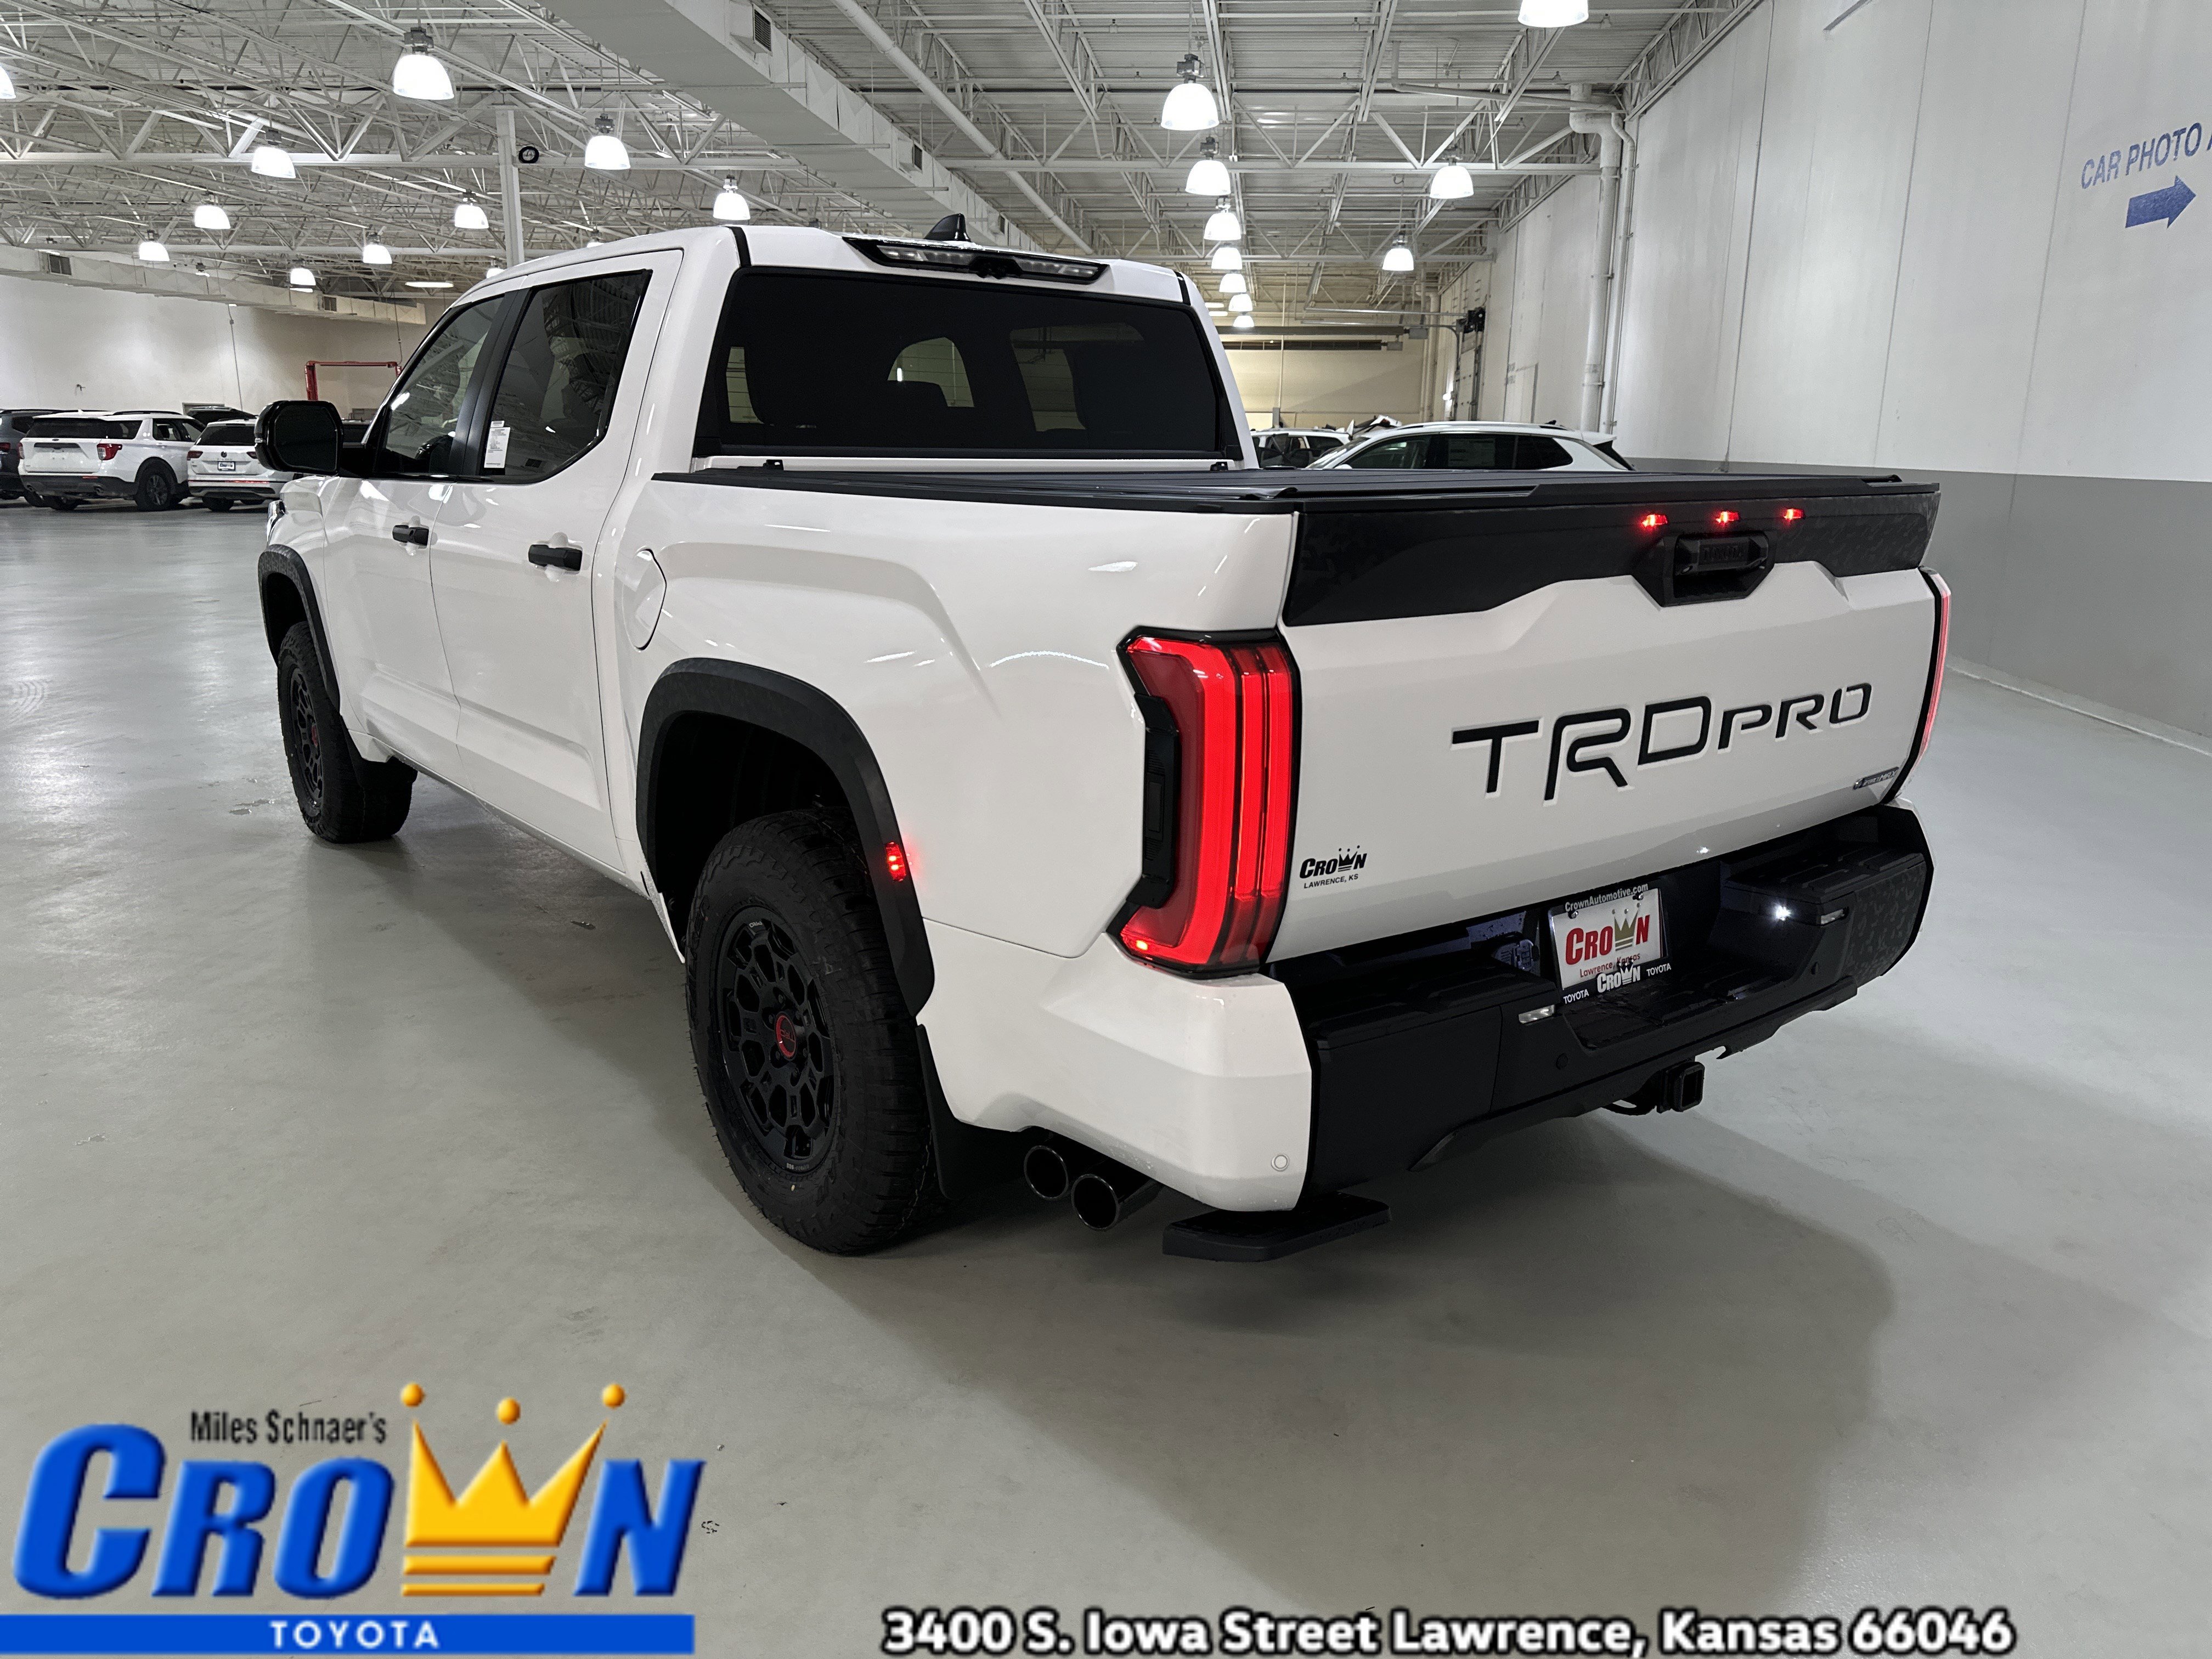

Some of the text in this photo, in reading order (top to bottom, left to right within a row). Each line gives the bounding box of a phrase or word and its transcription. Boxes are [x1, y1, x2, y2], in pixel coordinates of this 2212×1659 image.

[2081, 150, 2121, 189] CAR
[2125, 122, 2202, 176] PHOTO
[1299, 850, 1368, 879] CROWN
[1304, 876, 1347, 889] LAWRENCE,
[1565, 883, 1649, 911] CrownAutomotive.com
[1565, 909, 1650, 966] CROWN
[1564, 963, 1672, 1005] TOYOTA CROWN TOYOTA
[1579, 961, 1615, 978] Lawrence,
